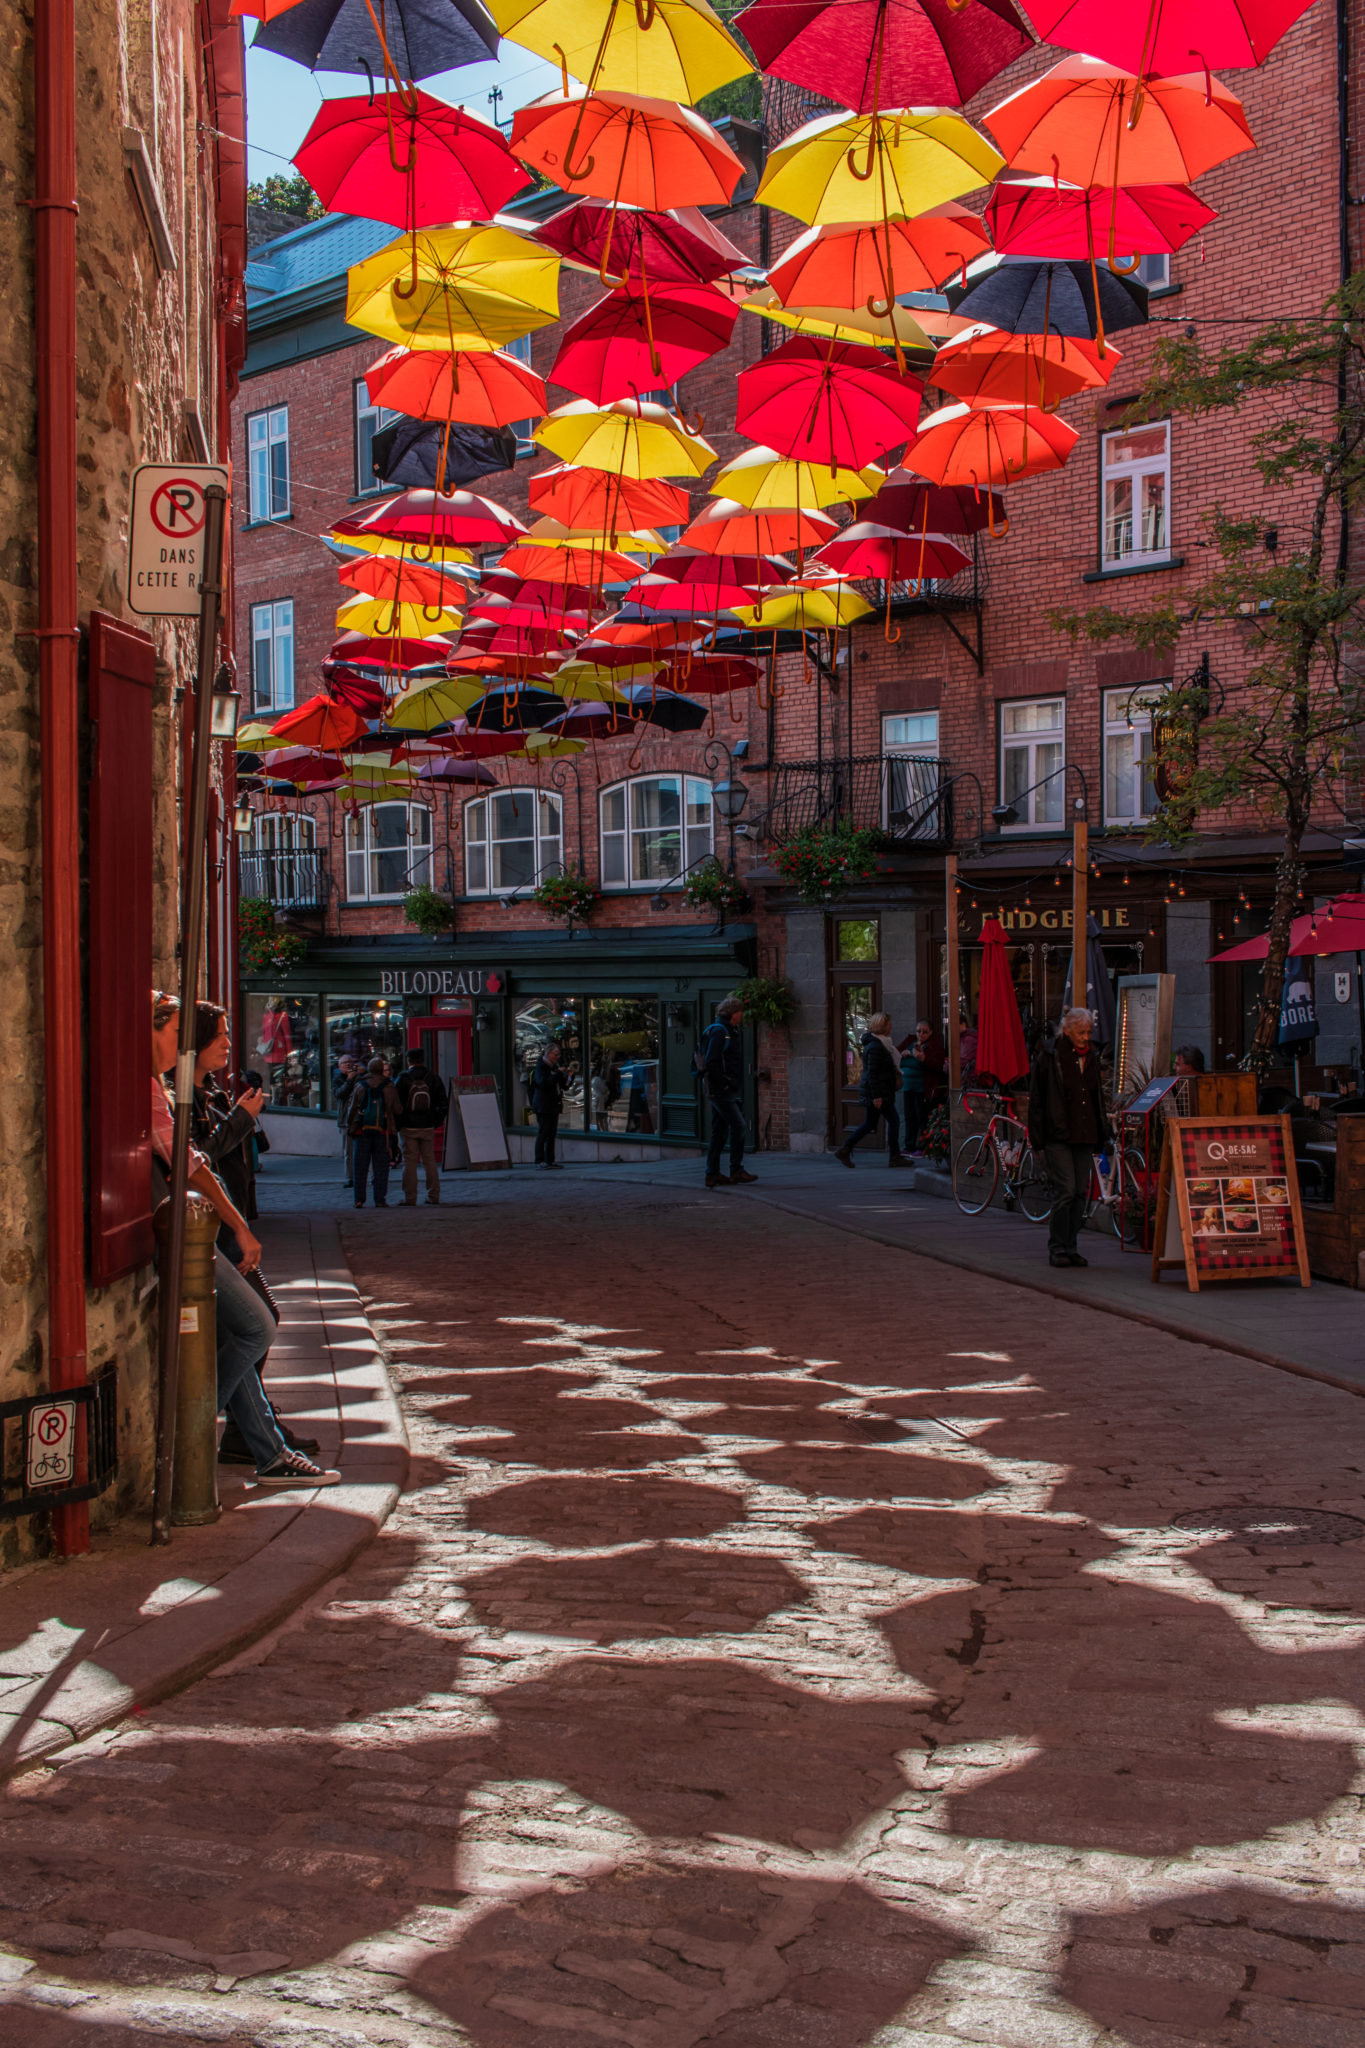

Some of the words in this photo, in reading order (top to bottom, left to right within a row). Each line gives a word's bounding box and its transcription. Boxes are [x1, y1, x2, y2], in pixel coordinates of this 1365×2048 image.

[160, 548, 195, 564] DANS
[137, 571, 178, 587] CETTE
[981, 907, 1130, 930] FUDGEIE
[380, 970, 482, 995] BILODEAU
